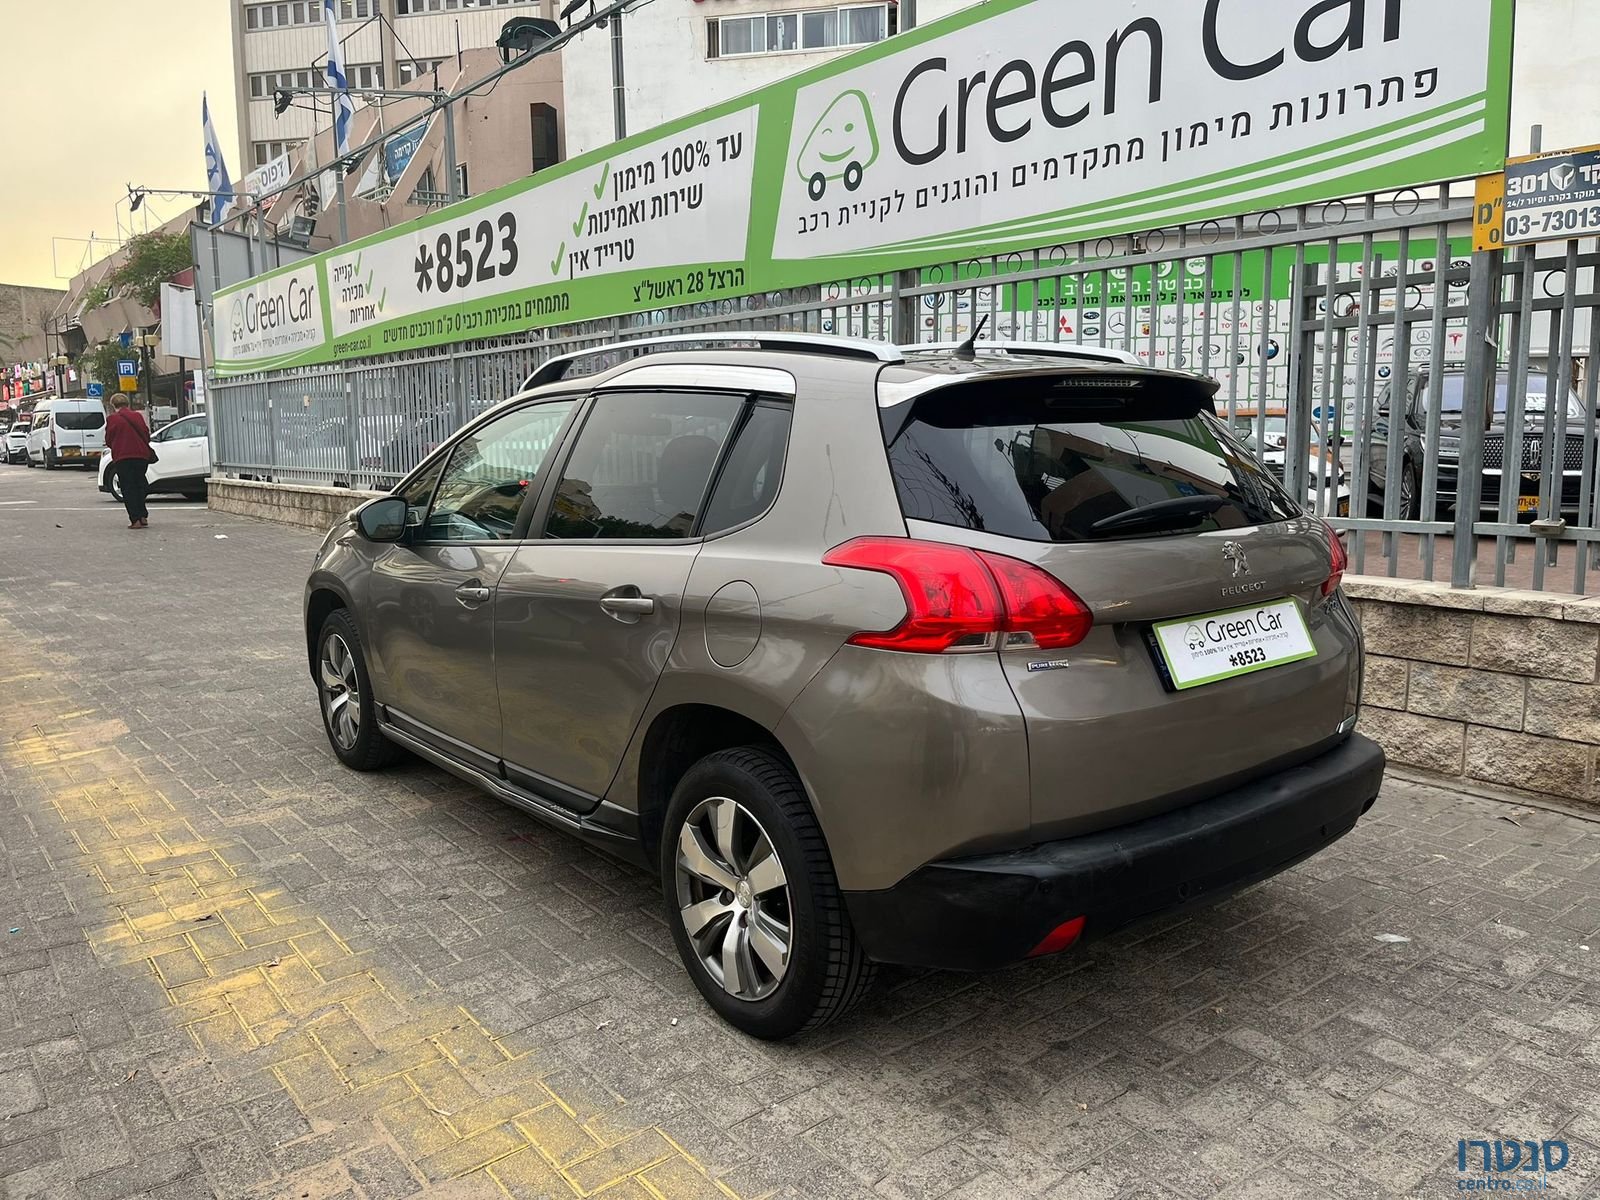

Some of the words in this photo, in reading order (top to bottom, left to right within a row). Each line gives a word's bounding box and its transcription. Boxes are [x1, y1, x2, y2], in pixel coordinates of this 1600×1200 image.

[893, 17, 1163, 165] Green
[1269, 66, 1439, 131] פתרונות
[716, 132, 743, 162] עד
[1161, 111, 1251, 162] מימון
[661, 139, 710, 179] 100%
[1012, 137, 1144, 188] מתקדמים
[612, 161, 655, 202] מימון
[916, 171, 998, 209] והוגנים
[1506, 172, 1549, 196] 301
[650, 183, 703, 220] שירות
[1506, 199, 1525, 208] 24/7
[1548, 192, 1572, 203] בקרה
[1573, 189, 1595, 200] מוקד
[587, 199, 646, 237] ואמינות
[798, 208, 830, 234] רכב
[837, 190, 906, 227] לקניית
[568, 249, 590, 280] אין
[593, 238, 635, 267] טרייד
[334, 263, 353, 283] קנייה
[686, 271, 704, 295] 28
[707, 267, 745, 291] הרצל
[245, 292, 286, 334] Green
[288, 277, 314, 323] Car
[342, 283, 364, 303] מכירה
[524, 292, 570, 318] מתמחים
[349, 303, 376, 324] אחריות
[454, 312, 462, 331] 0
[462, 311, 483, 330] רכבי
[484, 302, 522, 326] במכירת
[1220, 322, 1248, 330] TOTA
[383, 326, 408, 344] חדשים
[409, 320, 435, 338] ורכבים
[333, 334, 372, 358] green-car.co.il
[1220, 580, 1267, 597] PEUGEOT
[1205, 618, 1257, 643] Green
[1256, 610, 1283, 632] Car
